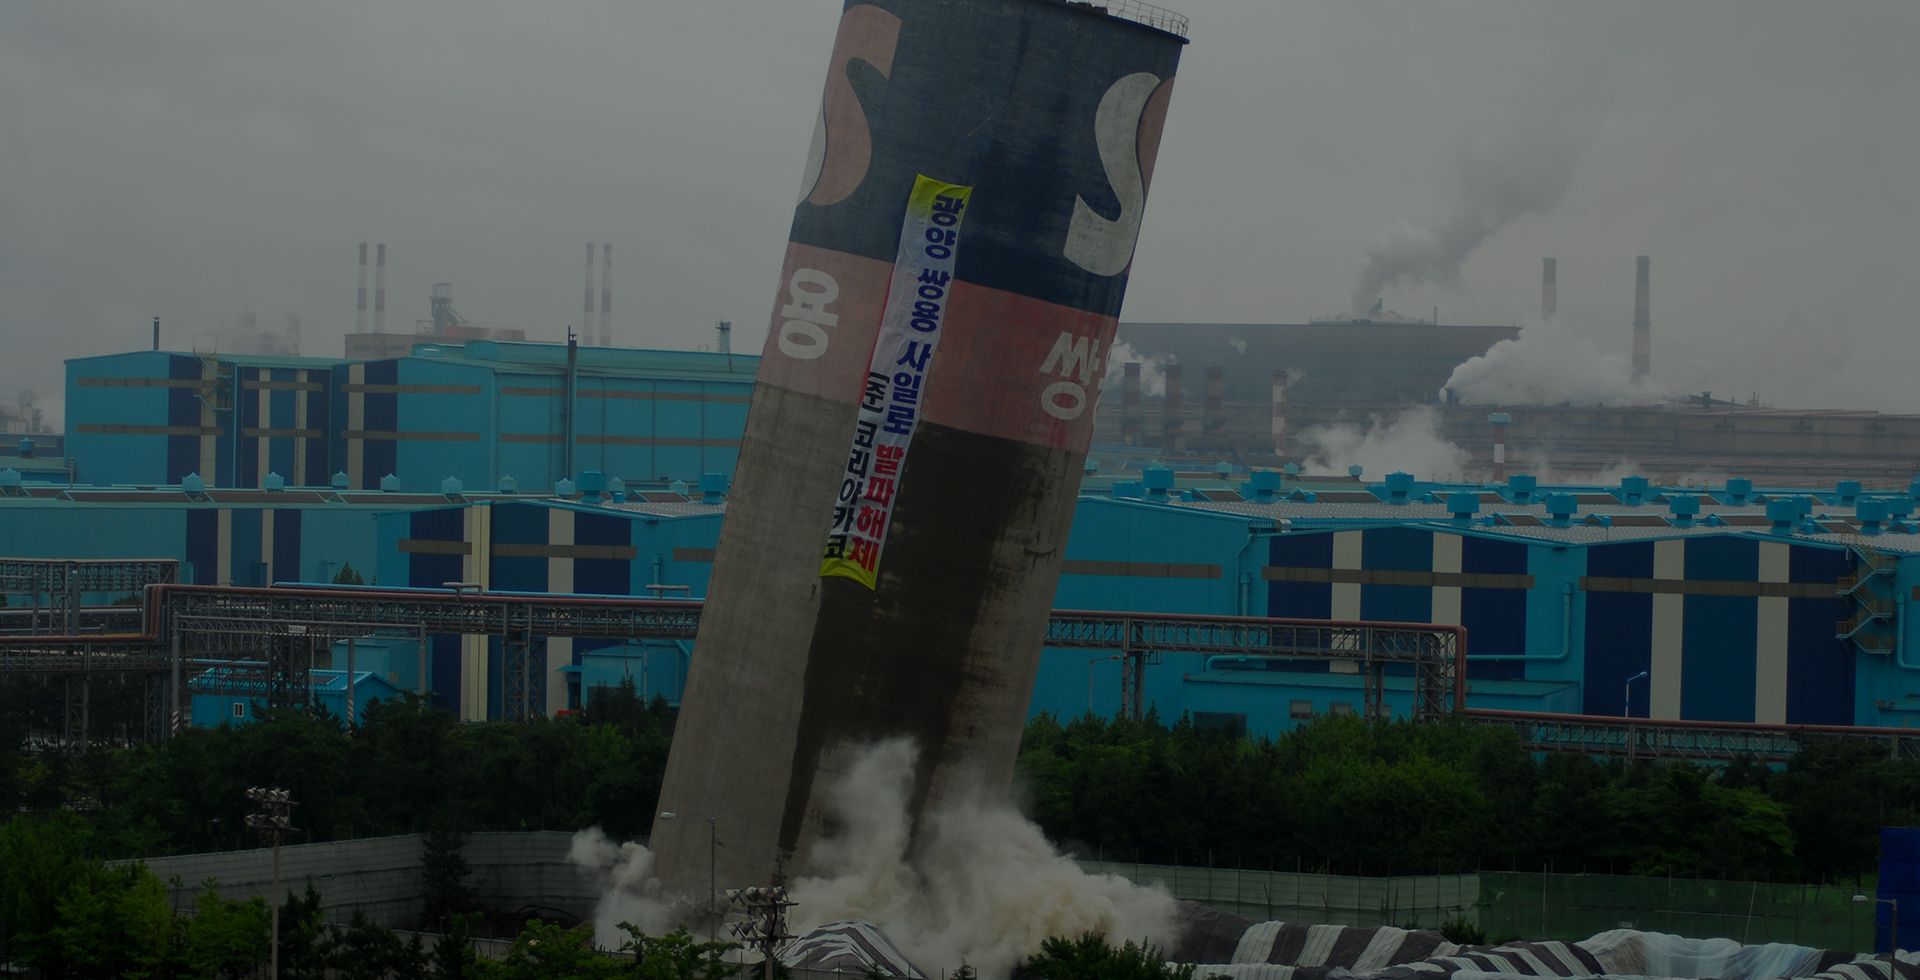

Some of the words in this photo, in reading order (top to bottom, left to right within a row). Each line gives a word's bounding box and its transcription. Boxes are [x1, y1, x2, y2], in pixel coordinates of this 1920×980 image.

[925, 194, 965, 260] 광양
[768, 268, 840, 360] 용
[910, 268, 951, 333] 쌍용
[883, 341, 931, 435] 사일로
[1039, 331, 1113, 425] 쌍
[823, 420, 878, 560] 코리아카코
[847, 444, 904, 573] 발파해체
